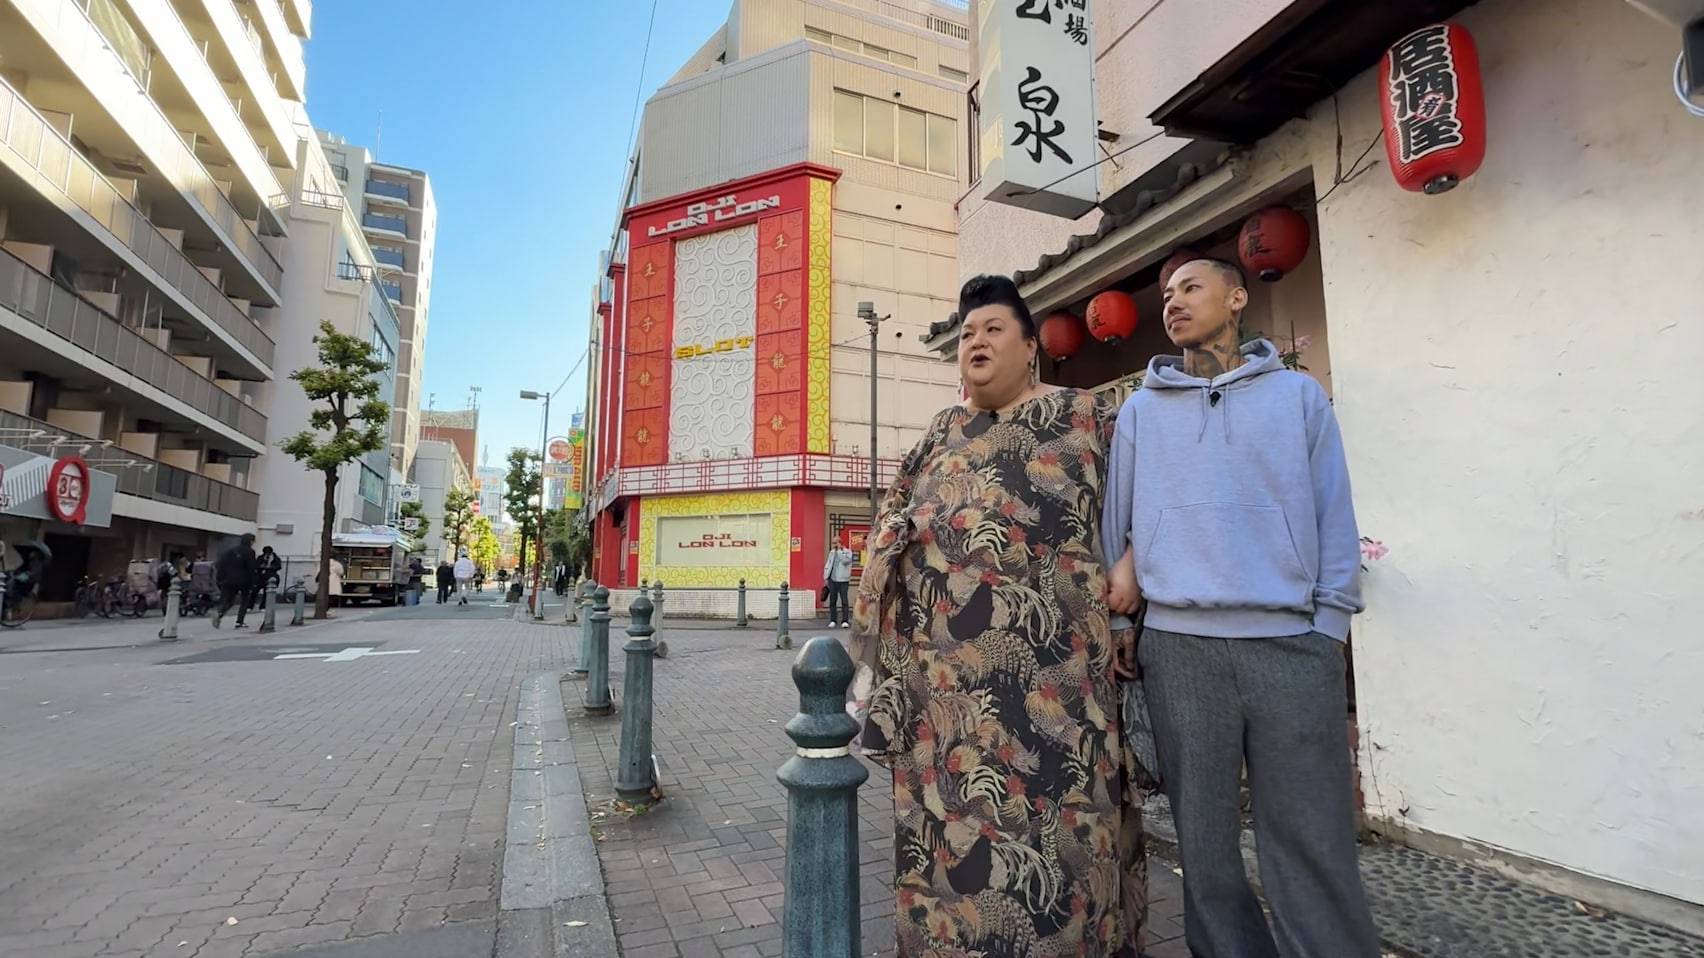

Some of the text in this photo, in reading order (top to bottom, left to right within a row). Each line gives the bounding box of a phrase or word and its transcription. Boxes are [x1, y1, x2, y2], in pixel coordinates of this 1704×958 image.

[1389, 25, 1463, 163] 居酒屋
[648, 195, 781, 237] LON LON
[675, 335, 754, 359] SLOT
[678, 540, 757, 549] LON LON
[702, 533, 732, 541] OJI
